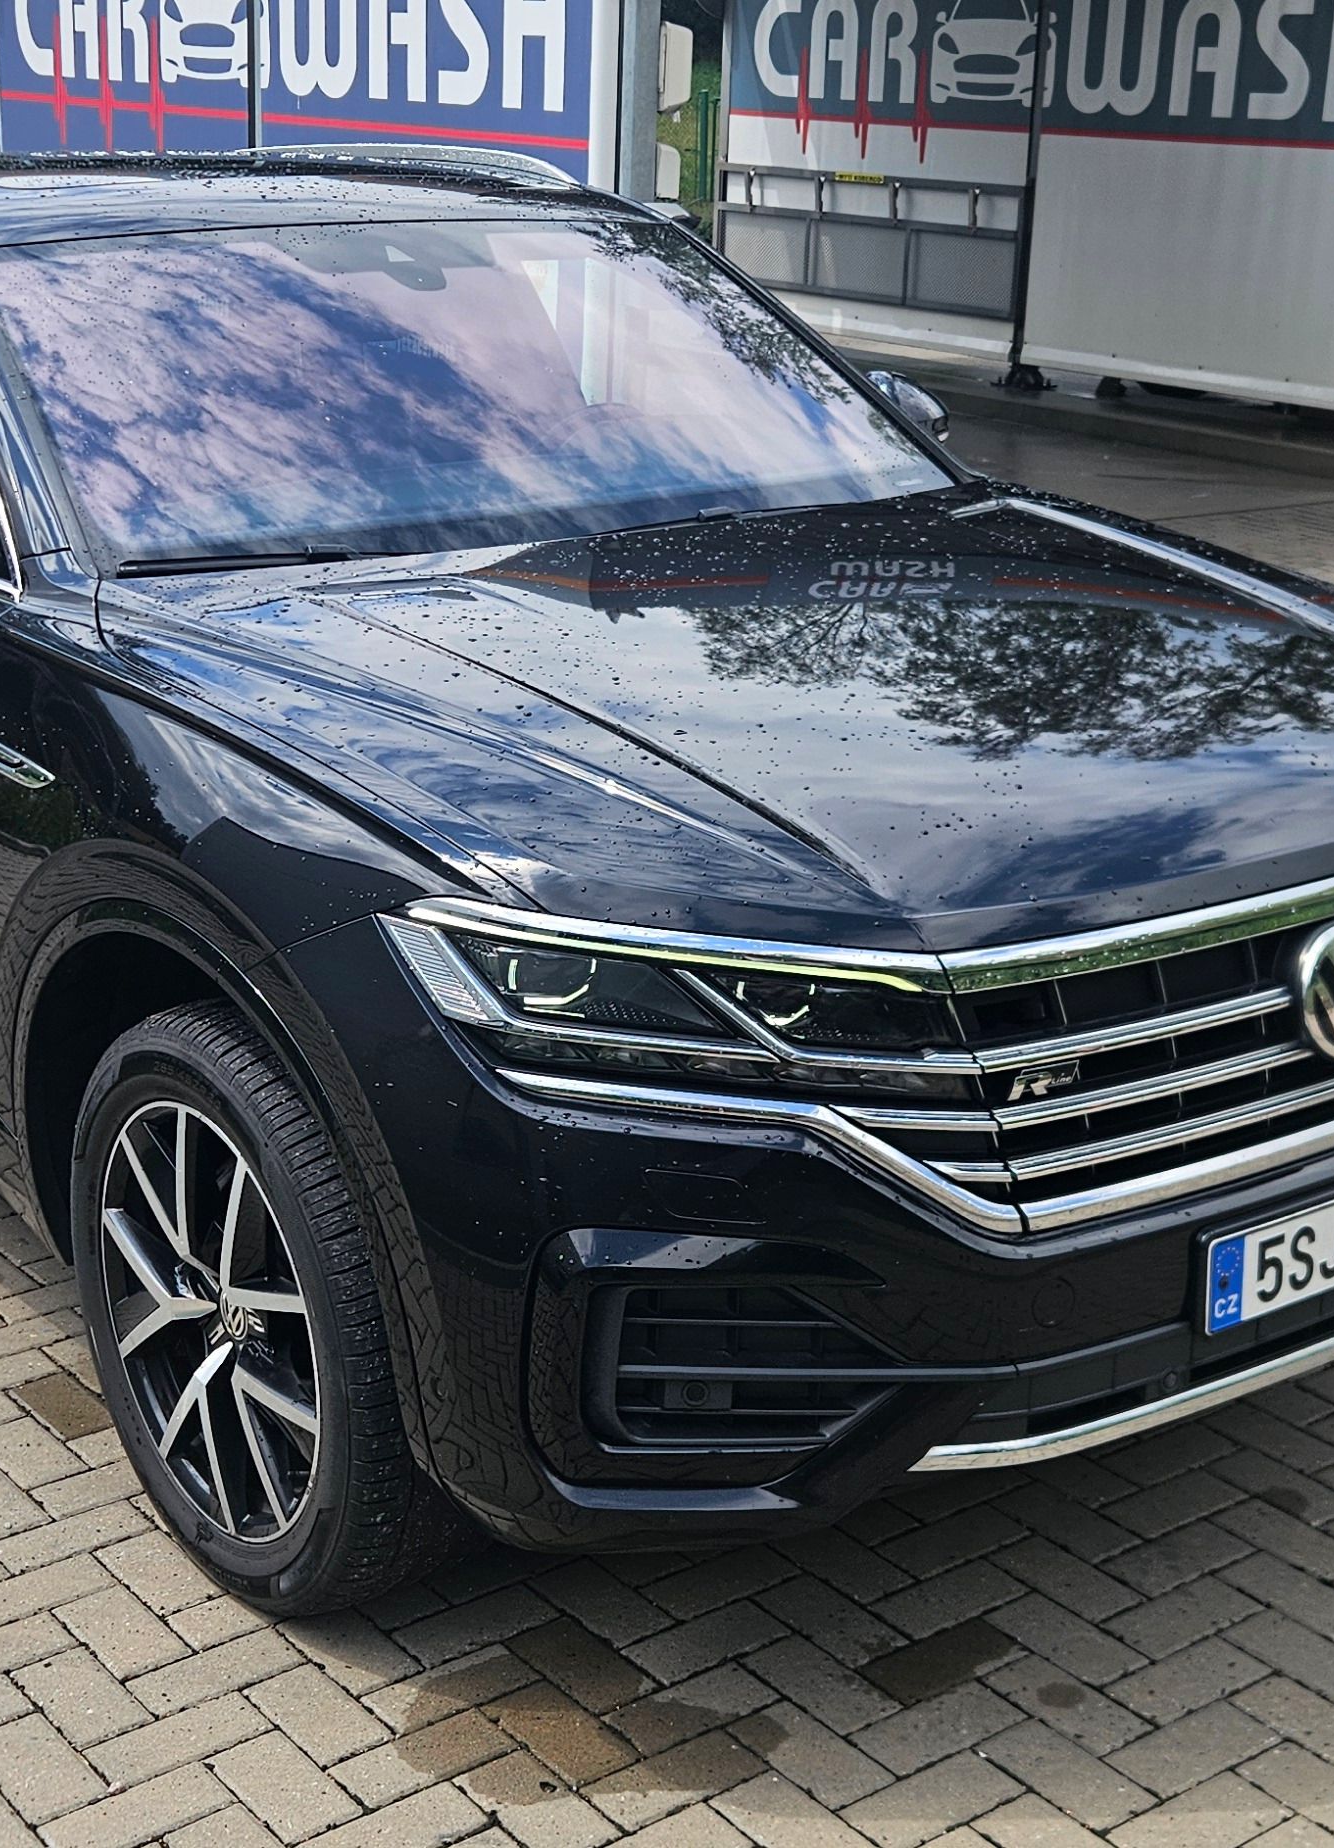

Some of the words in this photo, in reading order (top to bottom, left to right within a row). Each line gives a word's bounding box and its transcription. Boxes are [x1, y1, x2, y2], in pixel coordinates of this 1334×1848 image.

[14, 0, 150, 83] CAR
[279, 0, 566, 112] WASH
[754, 0, 919, 103] CAR
[1214, 1293, 1238, 1318] CZ
